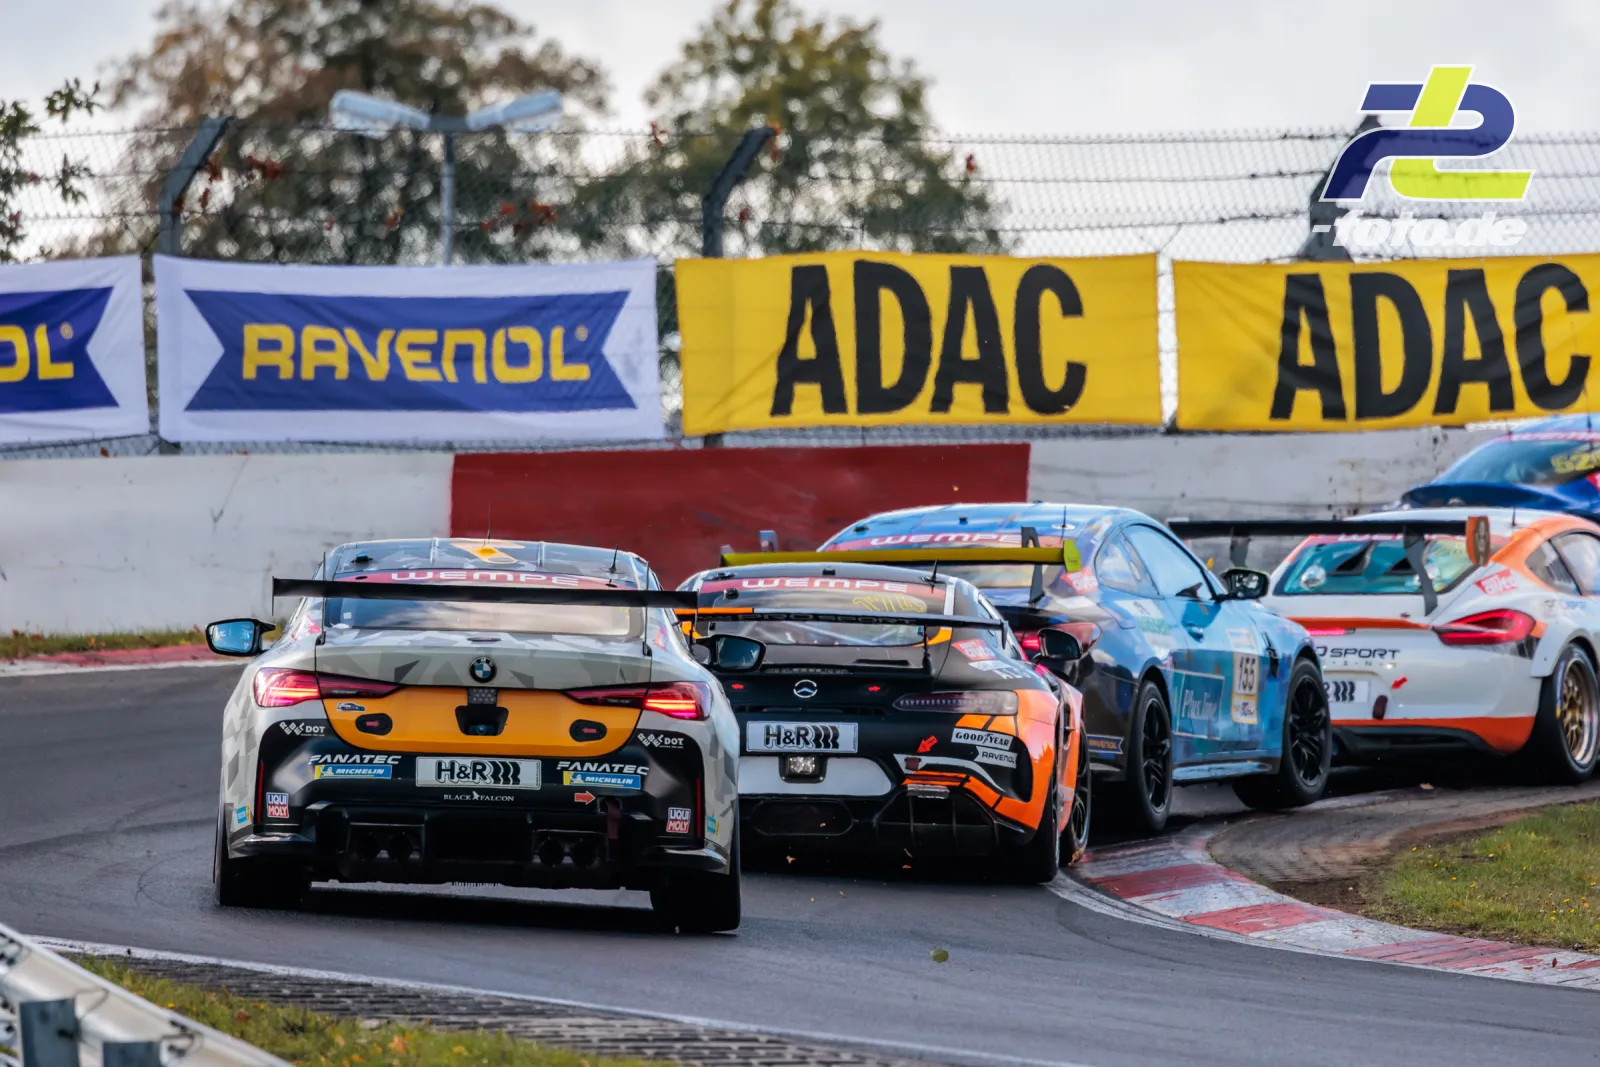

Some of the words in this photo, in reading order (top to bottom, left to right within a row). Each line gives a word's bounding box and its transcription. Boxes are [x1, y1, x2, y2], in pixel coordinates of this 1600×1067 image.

[770, 260, 1087, 417] ADAC
[1269, 263, 1591, 421] ADAC
[870, 532, 1021, 546] WEMPE
[391, 570, 579, 587] WEMPE
[742, 577, 908, 593] WEMPE
[1330, 647, 1401, 660] SPORT
[1238, 656, 1256, 691] 155
[279, 721, 305, 736] REBEL
[305, 725, 326, 733] DOT
[637, 732, 664, 748] REBEL
[664, 737, 684, 746] DOT
[764, 724, 812, 749] H&R
[955, 731, 1010, 747] GOODYEAR
[308, 754, 402, 765] FANATEC
[435, 760, 491, 784] H&R
[556, 761, 650, 776] FANATEC
[585, 776, 634, 785] MICHELIN
[267, 794, 287, 805] LIQUI
[268, 805, 288, 816] MOLY
[670, 809, 690, 820] LIQUI
[668, 820, 689, 831] MOLY
